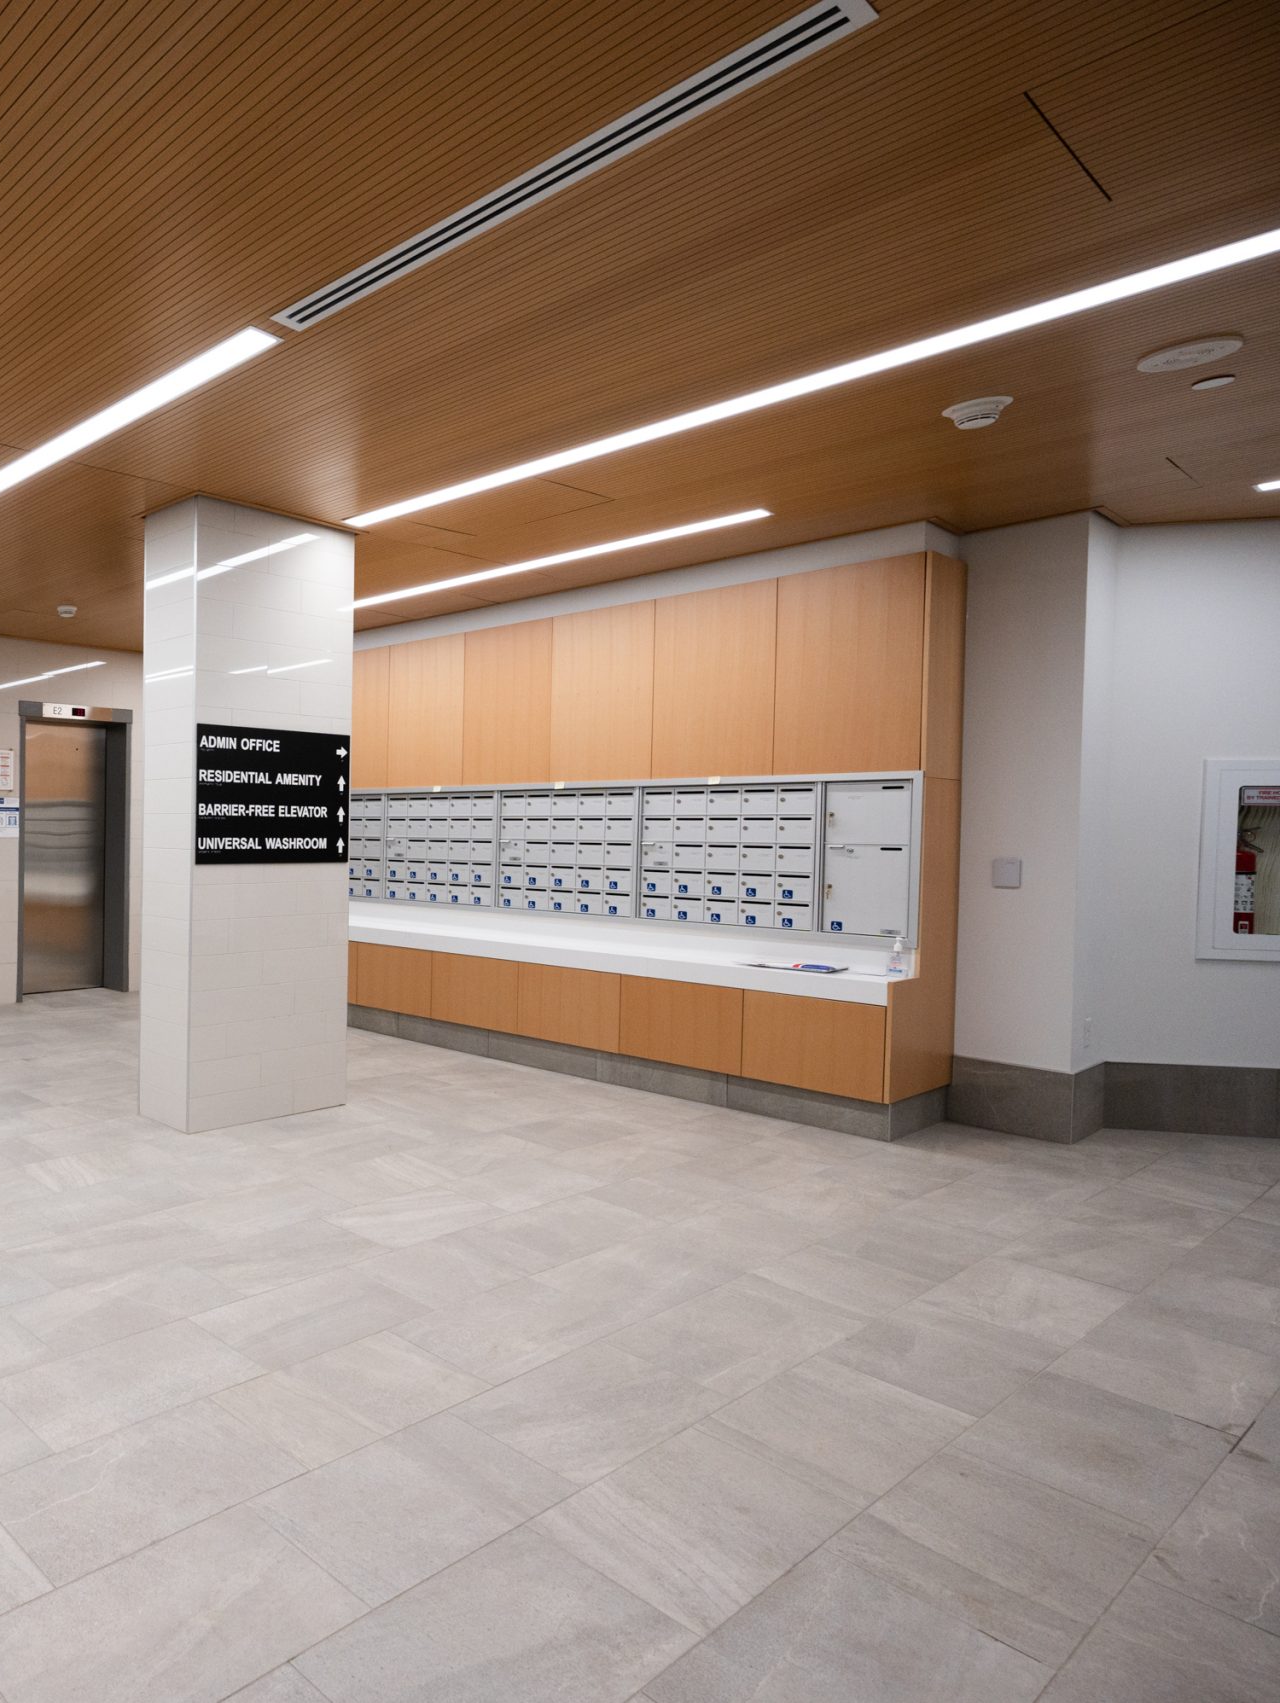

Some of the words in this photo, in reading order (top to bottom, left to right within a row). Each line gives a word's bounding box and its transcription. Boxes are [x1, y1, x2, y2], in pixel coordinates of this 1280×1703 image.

[52, 706, 63, 715] E2
[199, 735, 237, 750] ADMIN
[240, 738, 280, 752] OFFICE
[198, 769, 272, 784] RESIDENTIAL
[275, 773, 322, 786] AMENITY
[198, 803, 275, 817] BARRIER-FREE
[278, 805, 328, 818] ELEVATOR
[197, 837, 262, 850] UNIVERSAL
[265, 837, 328, 850] WASHROOM
